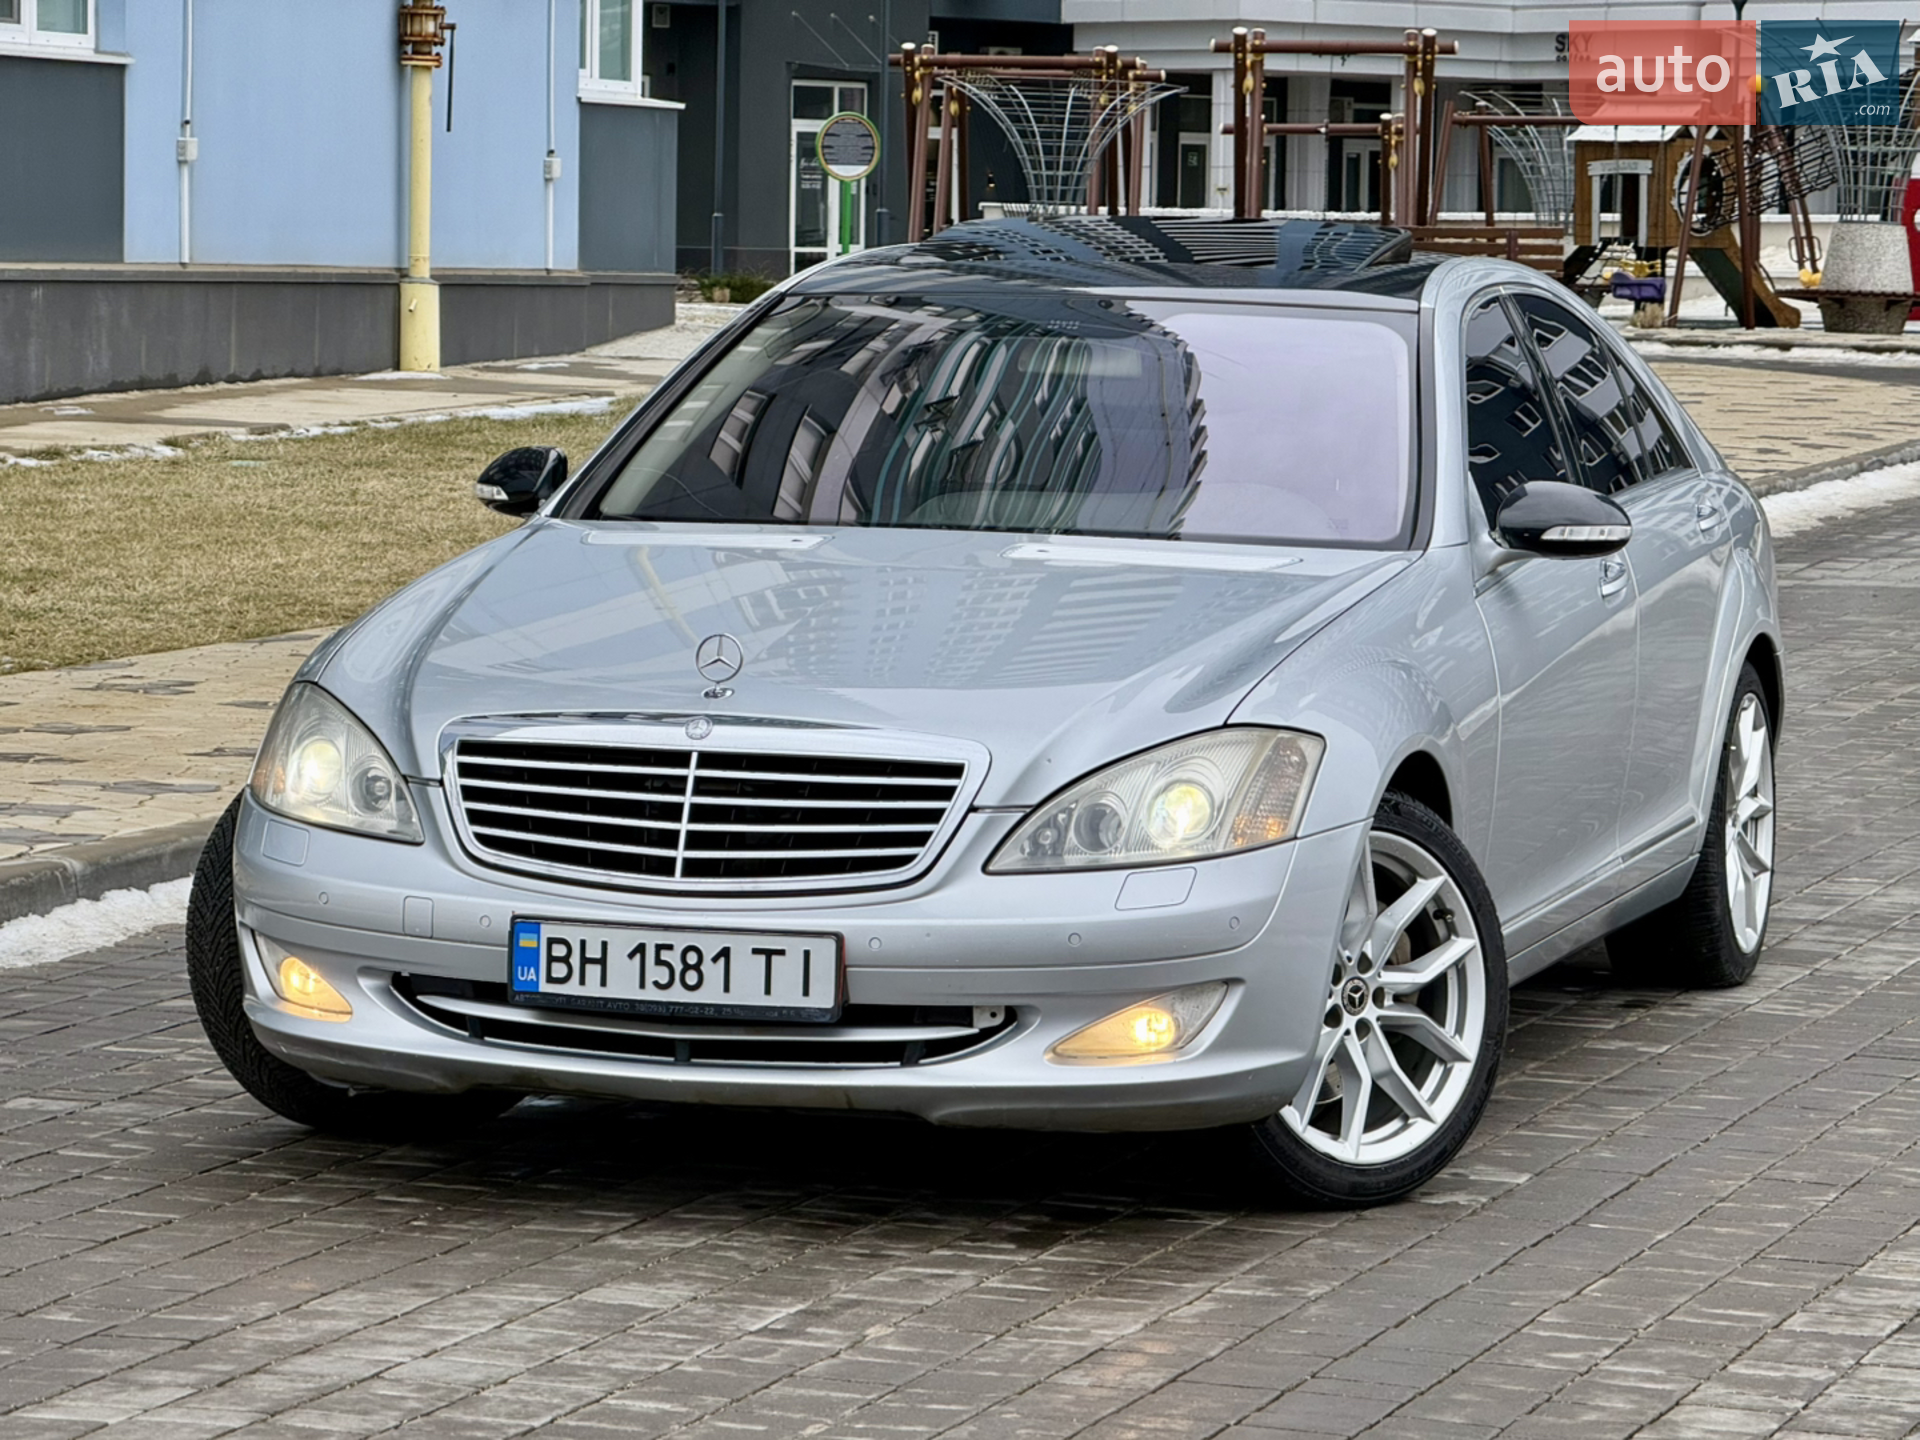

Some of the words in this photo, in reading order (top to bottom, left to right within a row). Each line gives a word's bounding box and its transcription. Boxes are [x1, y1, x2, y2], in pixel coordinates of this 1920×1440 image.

[1555, 33, 1593, 52] SKY
[517, 966, 537, 982] UA
[545, 937, 608, 987] BH
[627, 941, 731, 993] 1581
